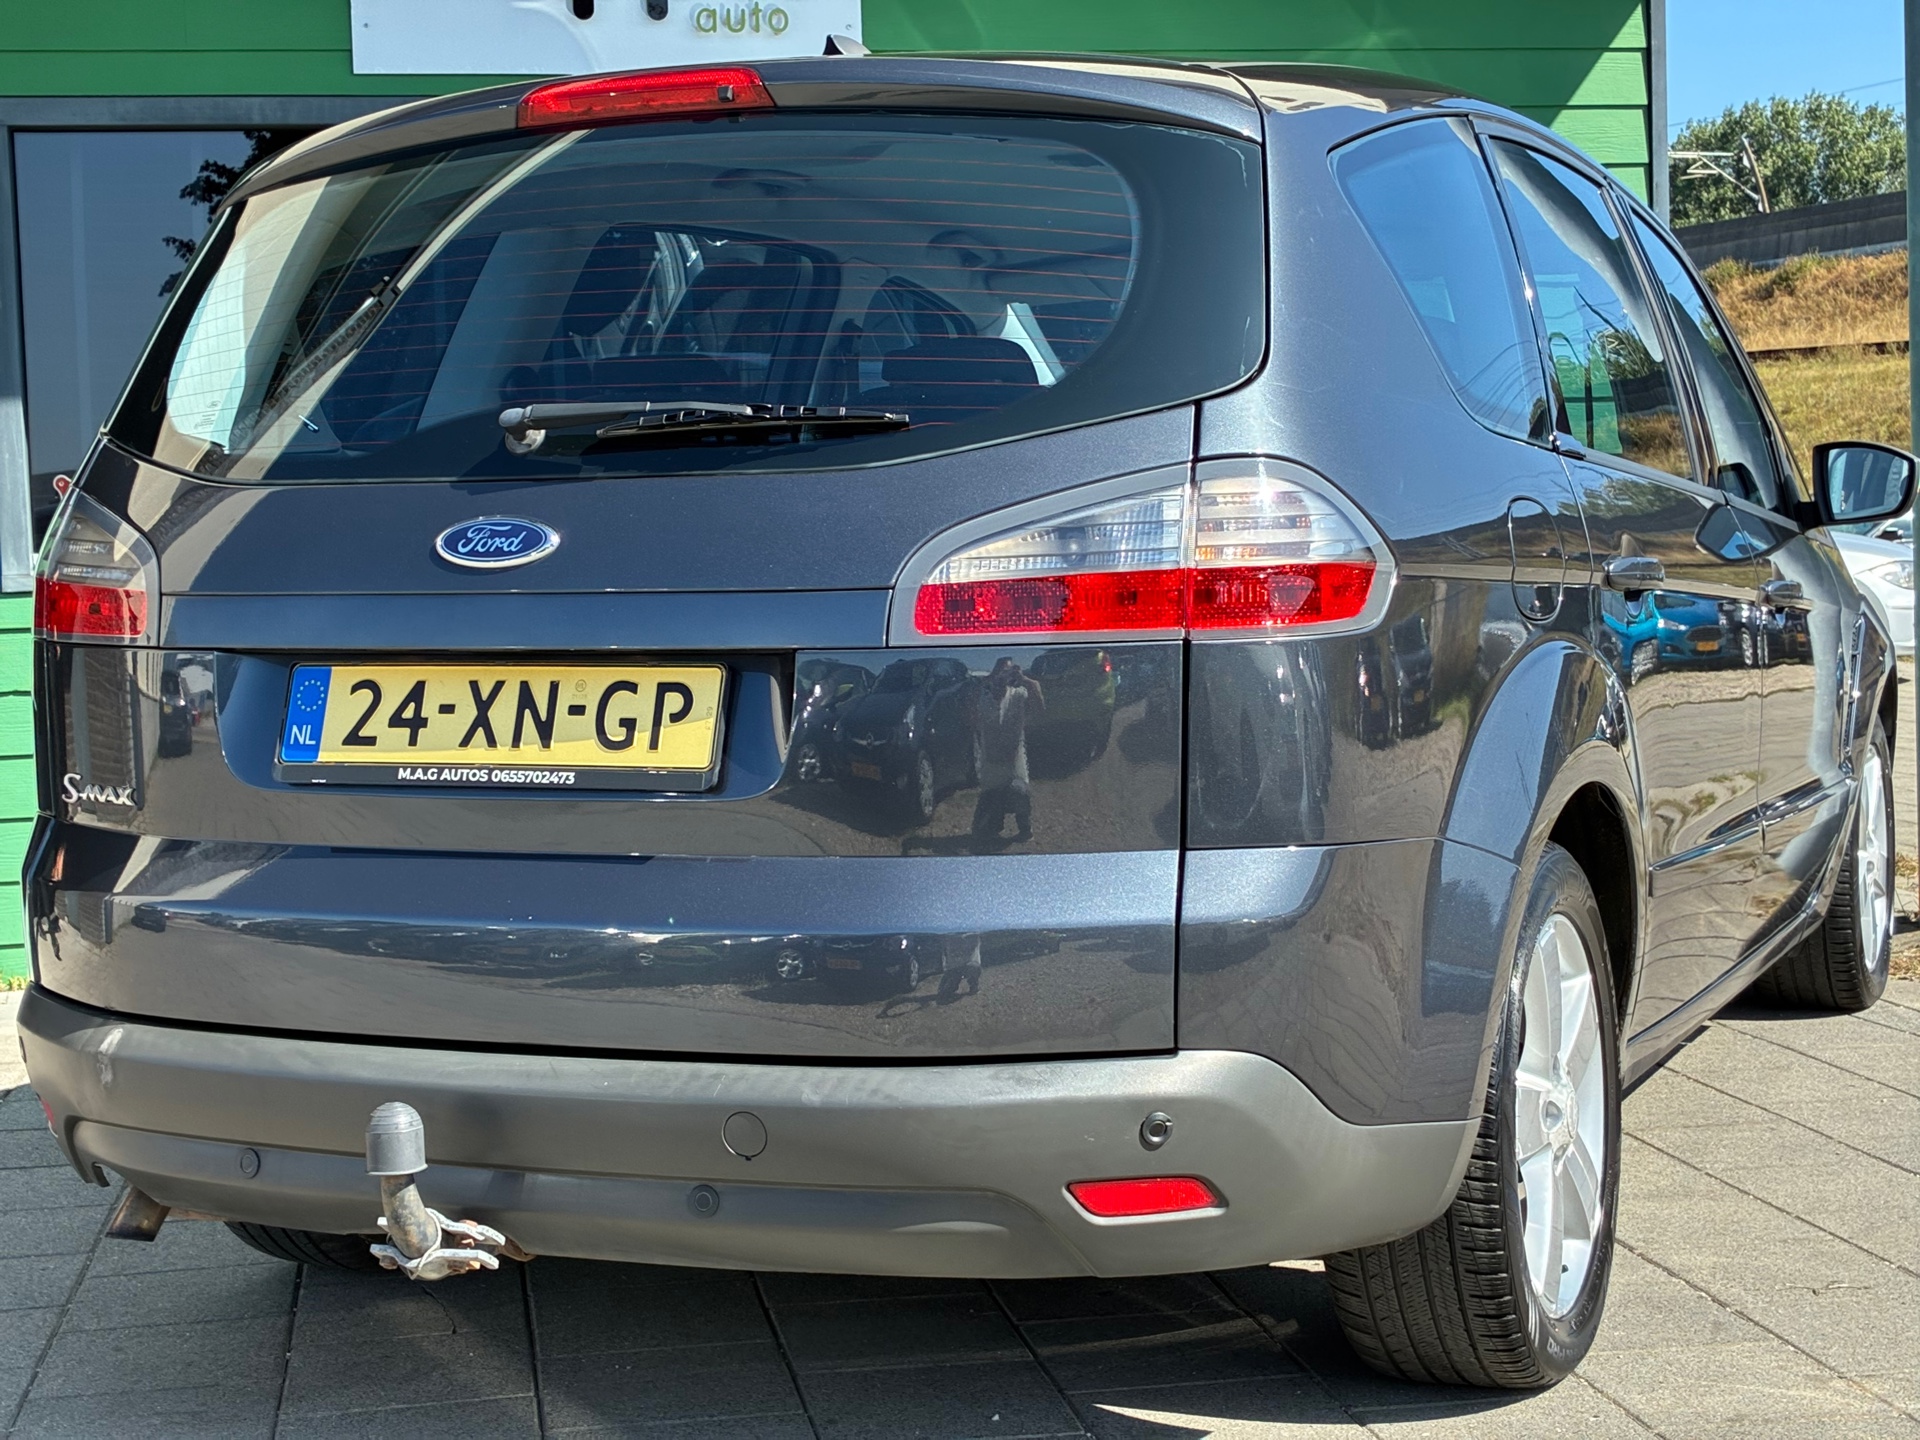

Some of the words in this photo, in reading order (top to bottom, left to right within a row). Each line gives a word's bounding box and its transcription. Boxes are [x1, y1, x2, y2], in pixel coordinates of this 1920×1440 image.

[695, 1, 790, 34] auto
[457, 525, 527, 553] Ford
[341, 678, 694, 751] 24-XN-GP
[290, 724, 316, 745] NL
[398, 767, 438, 781] M.A.G
[440, 769, 489, 782] AUTOS
[491, 769, 576, 785] 0655702473
